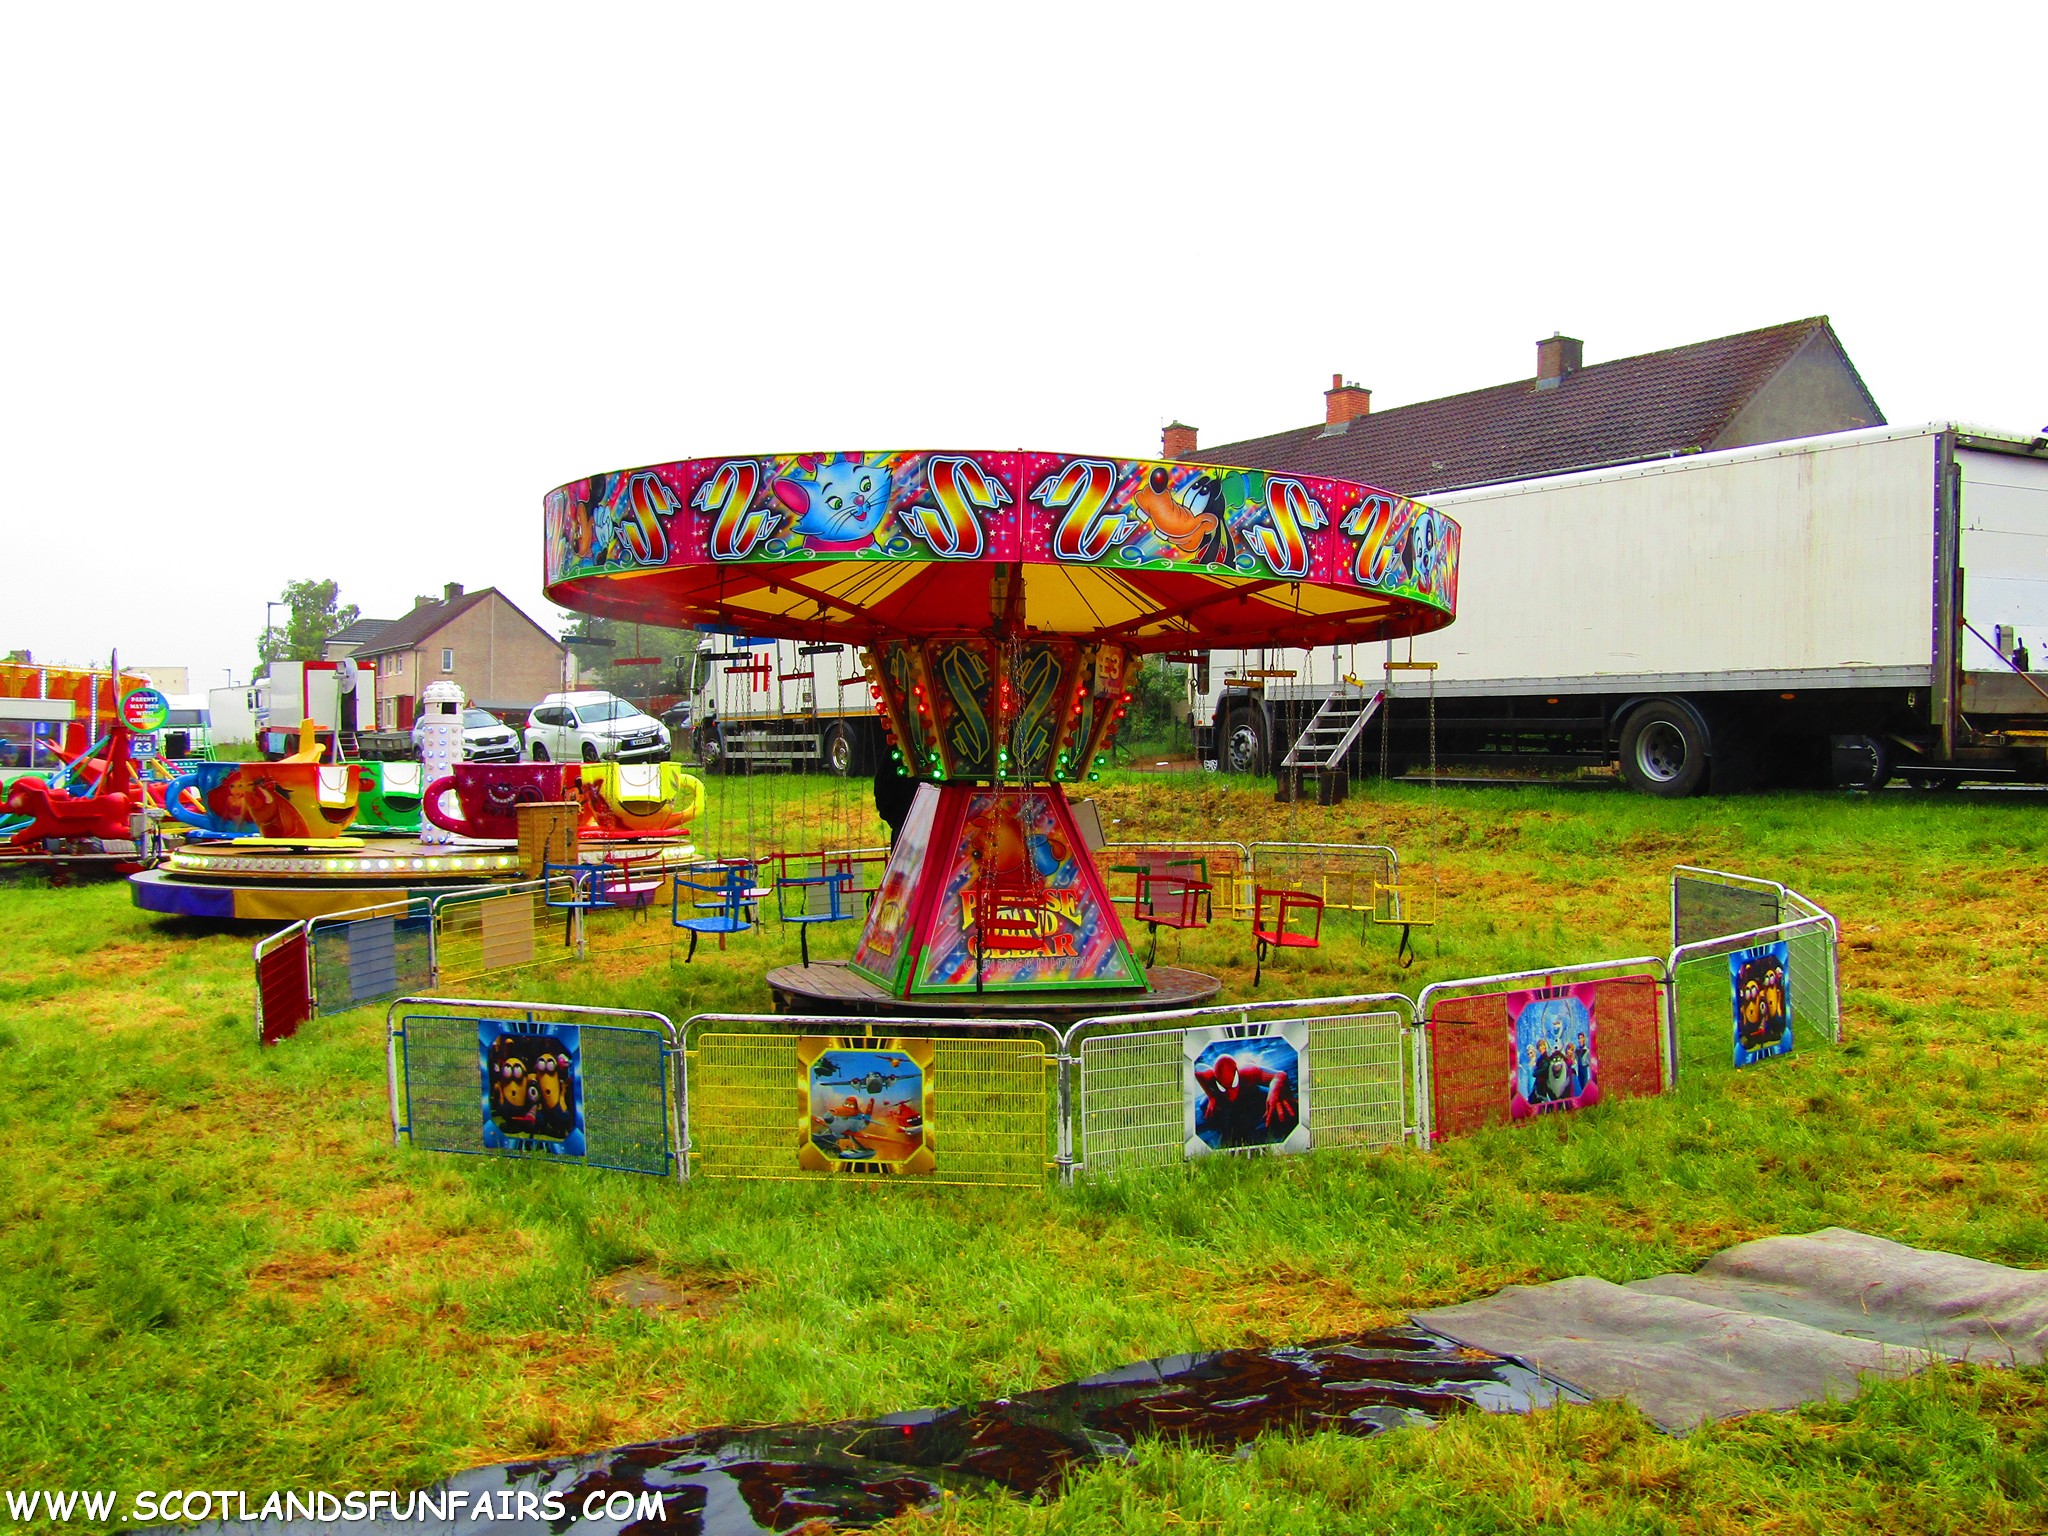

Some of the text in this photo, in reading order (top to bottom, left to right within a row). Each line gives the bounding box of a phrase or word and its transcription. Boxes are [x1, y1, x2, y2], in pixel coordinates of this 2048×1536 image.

[1099, 654, 1120, 679] £3
[133, 742, 152, 752] £3
[959, 888, 1082, 930] PSE
[985, 907, 1058, 937] TAND
[963, 959, 995, 972] WEN
